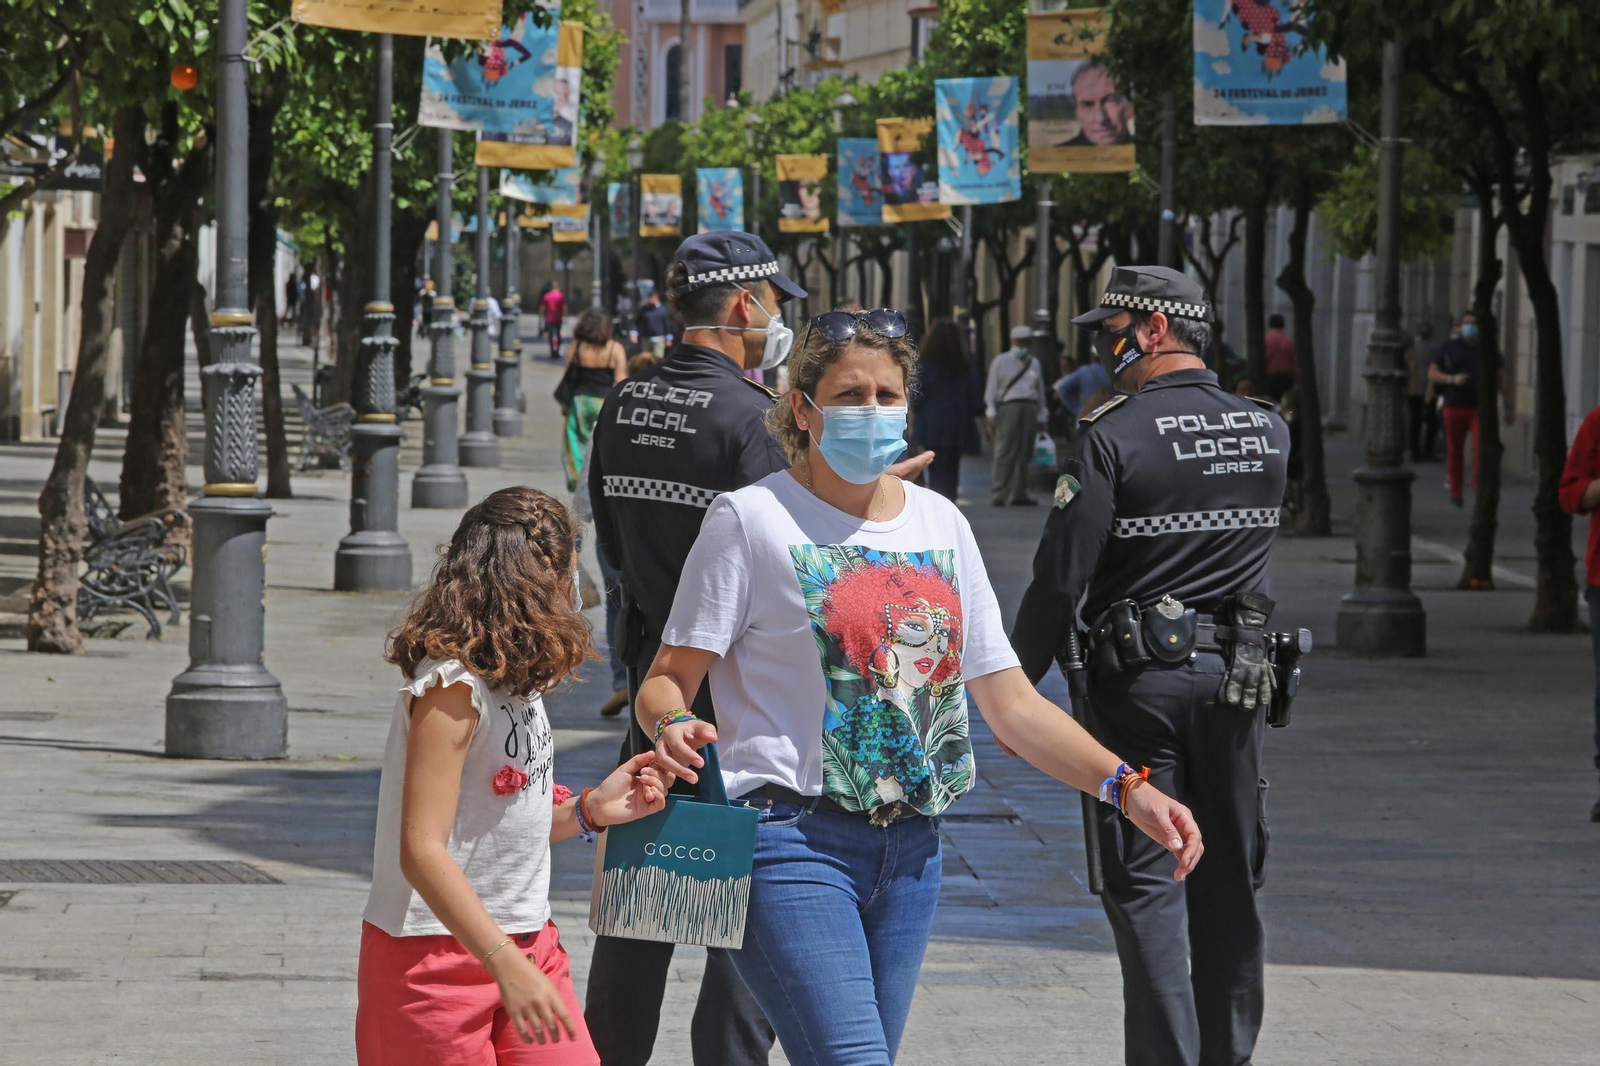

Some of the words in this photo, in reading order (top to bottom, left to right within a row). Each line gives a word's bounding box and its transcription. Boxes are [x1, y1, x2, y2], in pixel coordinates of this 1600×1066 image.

[451, 94, 493, 108] FESTIVAL
[508, 99, 538, 109] JEREZ
[1213, 88, 1226, 99] 24
[1228, 88, 1278, 99] FESTIVAL
[1294, 86, 1328, 98] JEREZ
[619, 381, 714, 408] POLICIA
[616, 406, 697, 434] LOCAL
[1155, 411, 1273, 435] POLICIA
[631, 433, 676, 449] JEREZ
[1172, 436, 1280, 460] LOCAL
[1203, 460, 1264, 475] JEREZ
[644, 842, 716, 862] GOCCO
